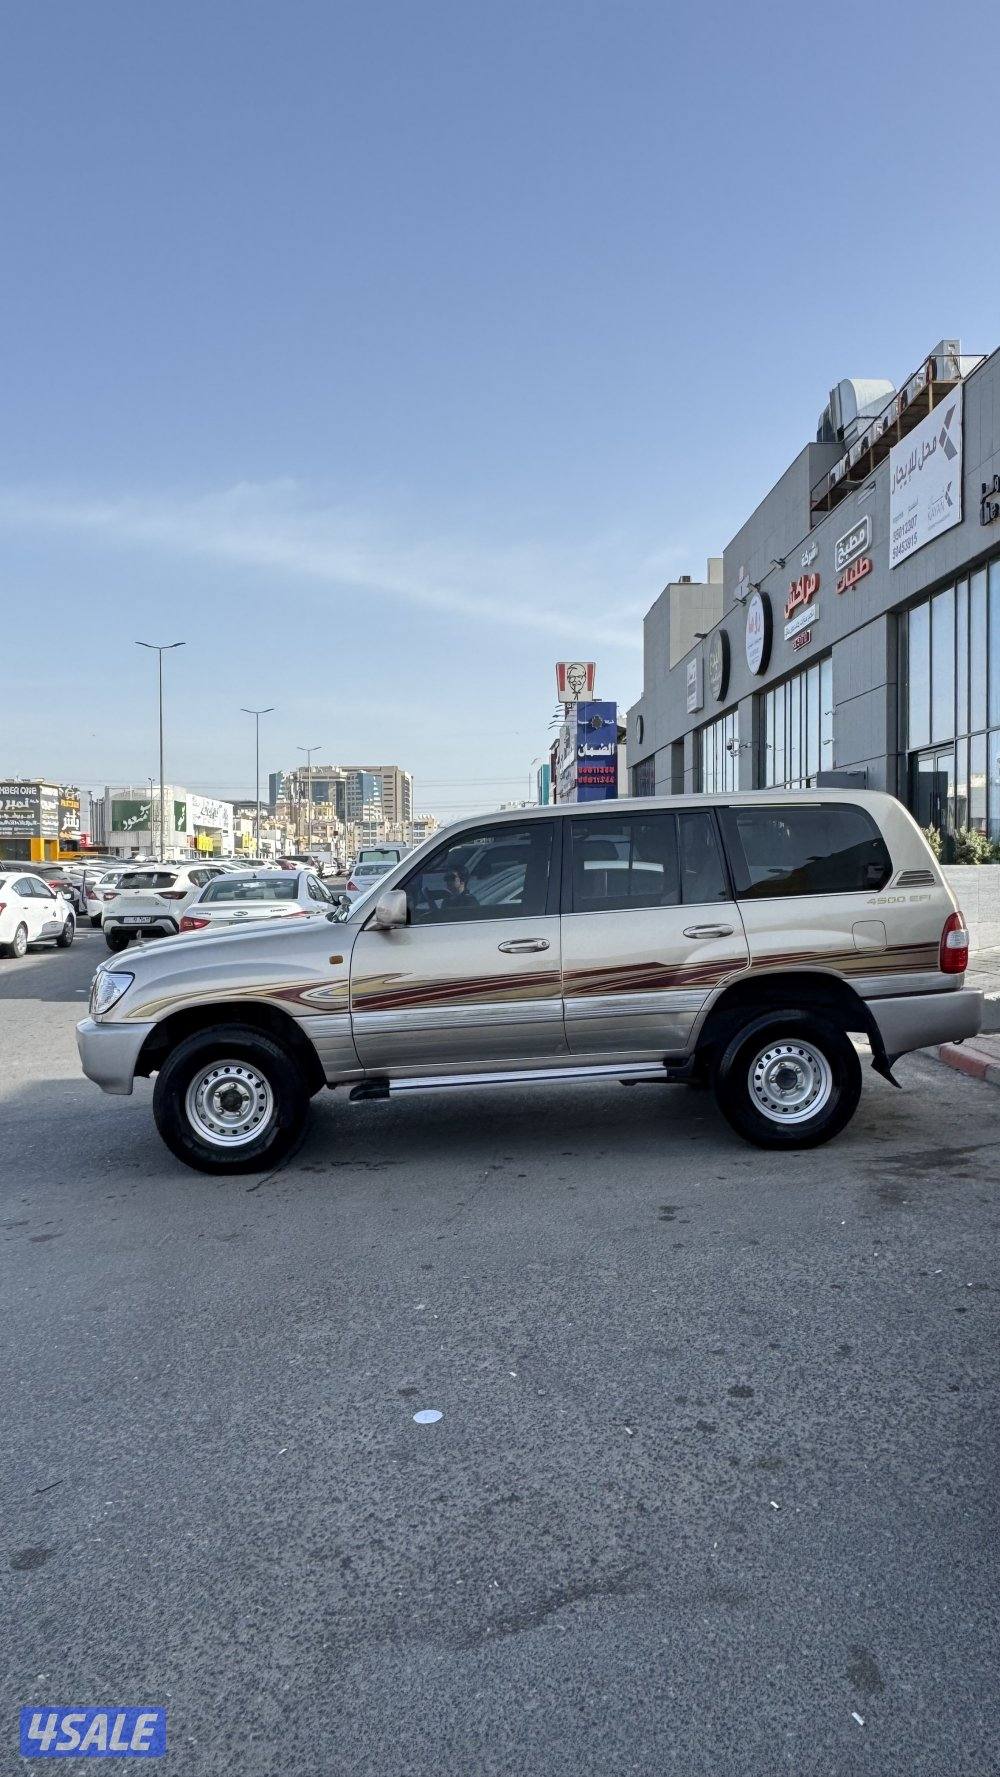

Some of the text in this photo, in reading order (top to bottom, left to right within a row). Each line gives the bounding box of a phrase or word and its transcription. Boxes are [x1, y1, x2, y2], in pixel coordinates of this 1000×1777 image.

[918, 434, 937, 471] محل
[837, 528, 866, 563] مطبخ
[836, 556, 873, 594] طلبات
[784, 572, 820, 619] مراكش
[577, 742, 615, 757] الضمان
[866, 894, 931, 905] 4500 EFI
